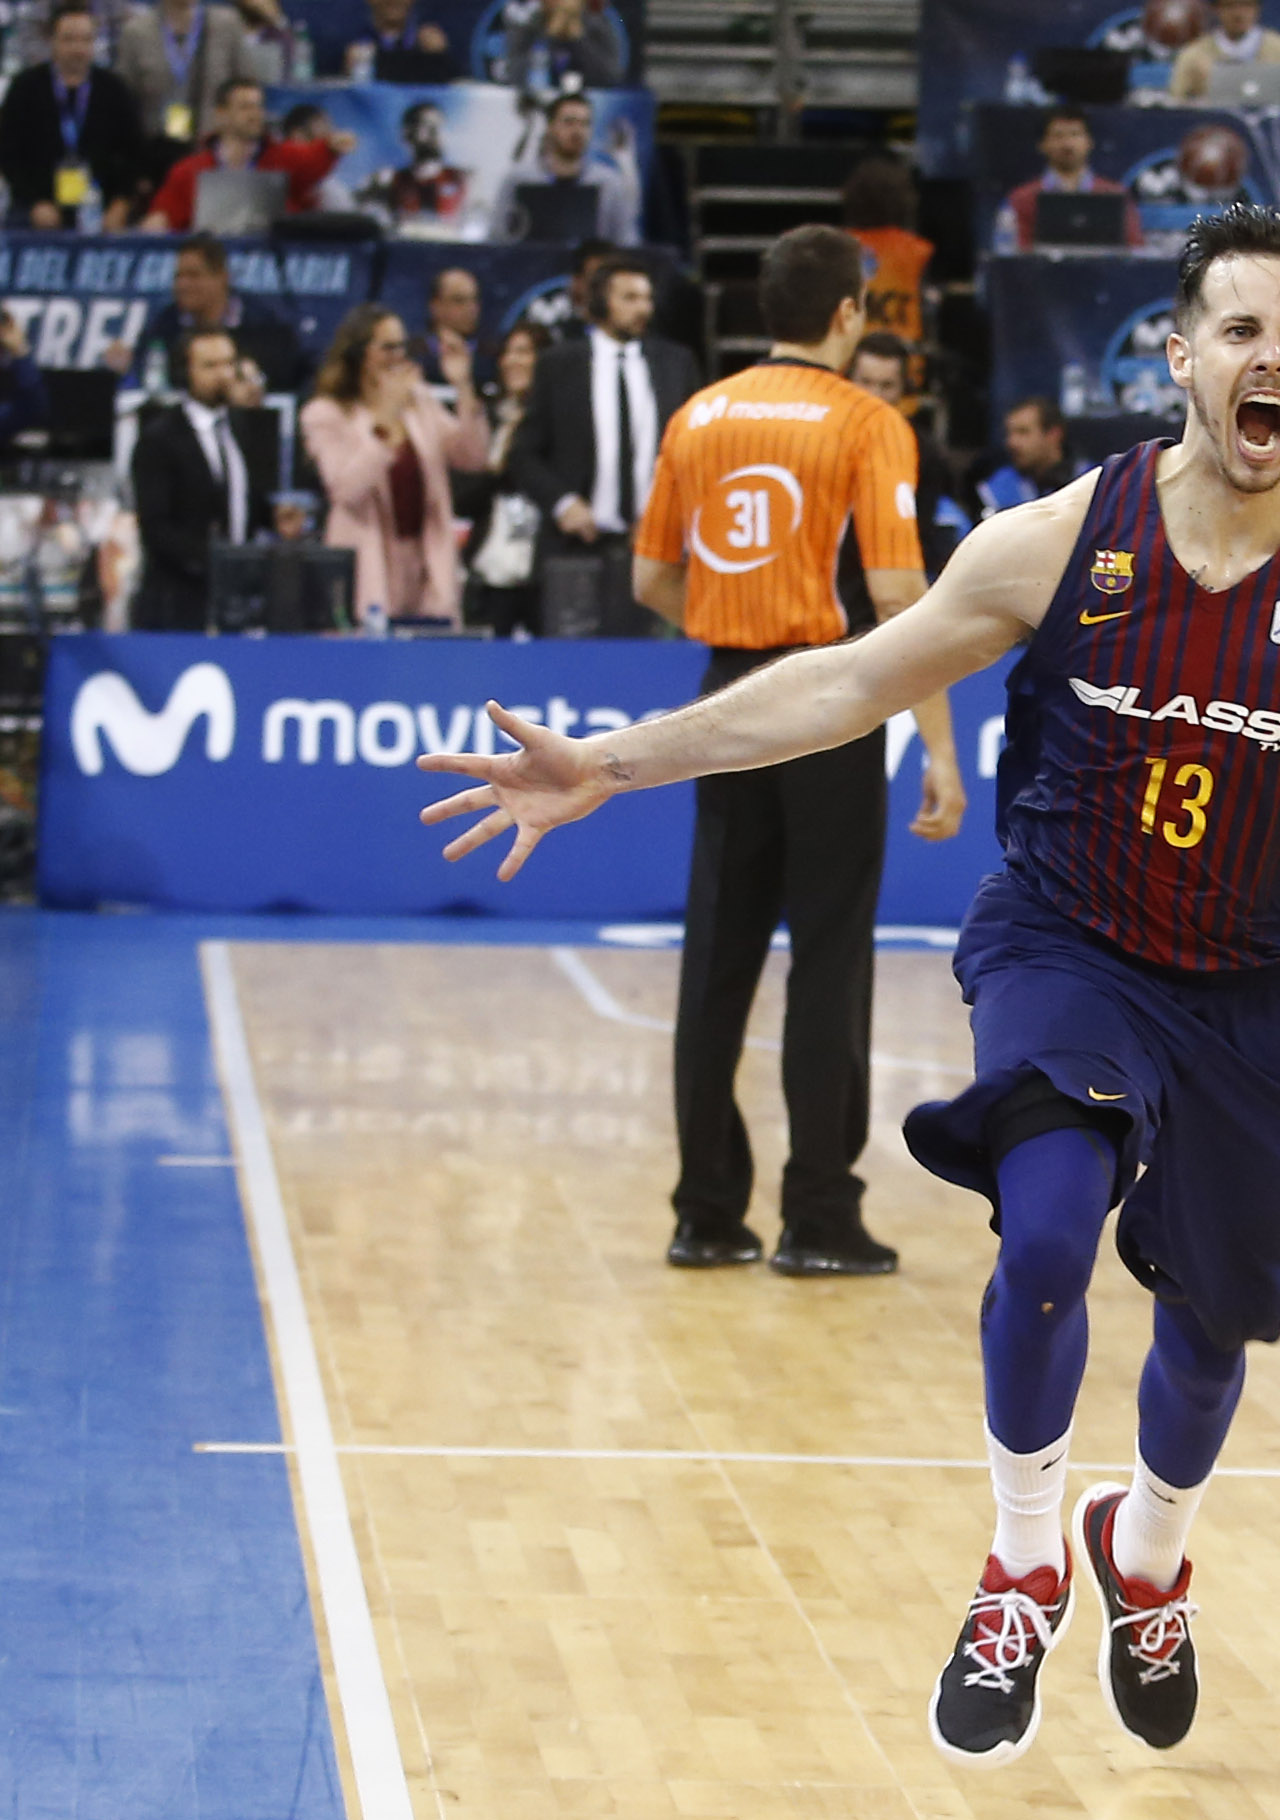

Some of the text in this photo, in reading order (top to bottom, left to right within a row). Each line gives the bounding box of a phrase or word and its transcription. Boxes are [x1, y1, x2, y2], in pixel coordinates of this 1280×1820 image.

[728, 401, 830, 422] movistar
[726, 490, 769, 548] 31
[262, 697, 682, 767] movista
[1141, 756, 1214, 849] 13
